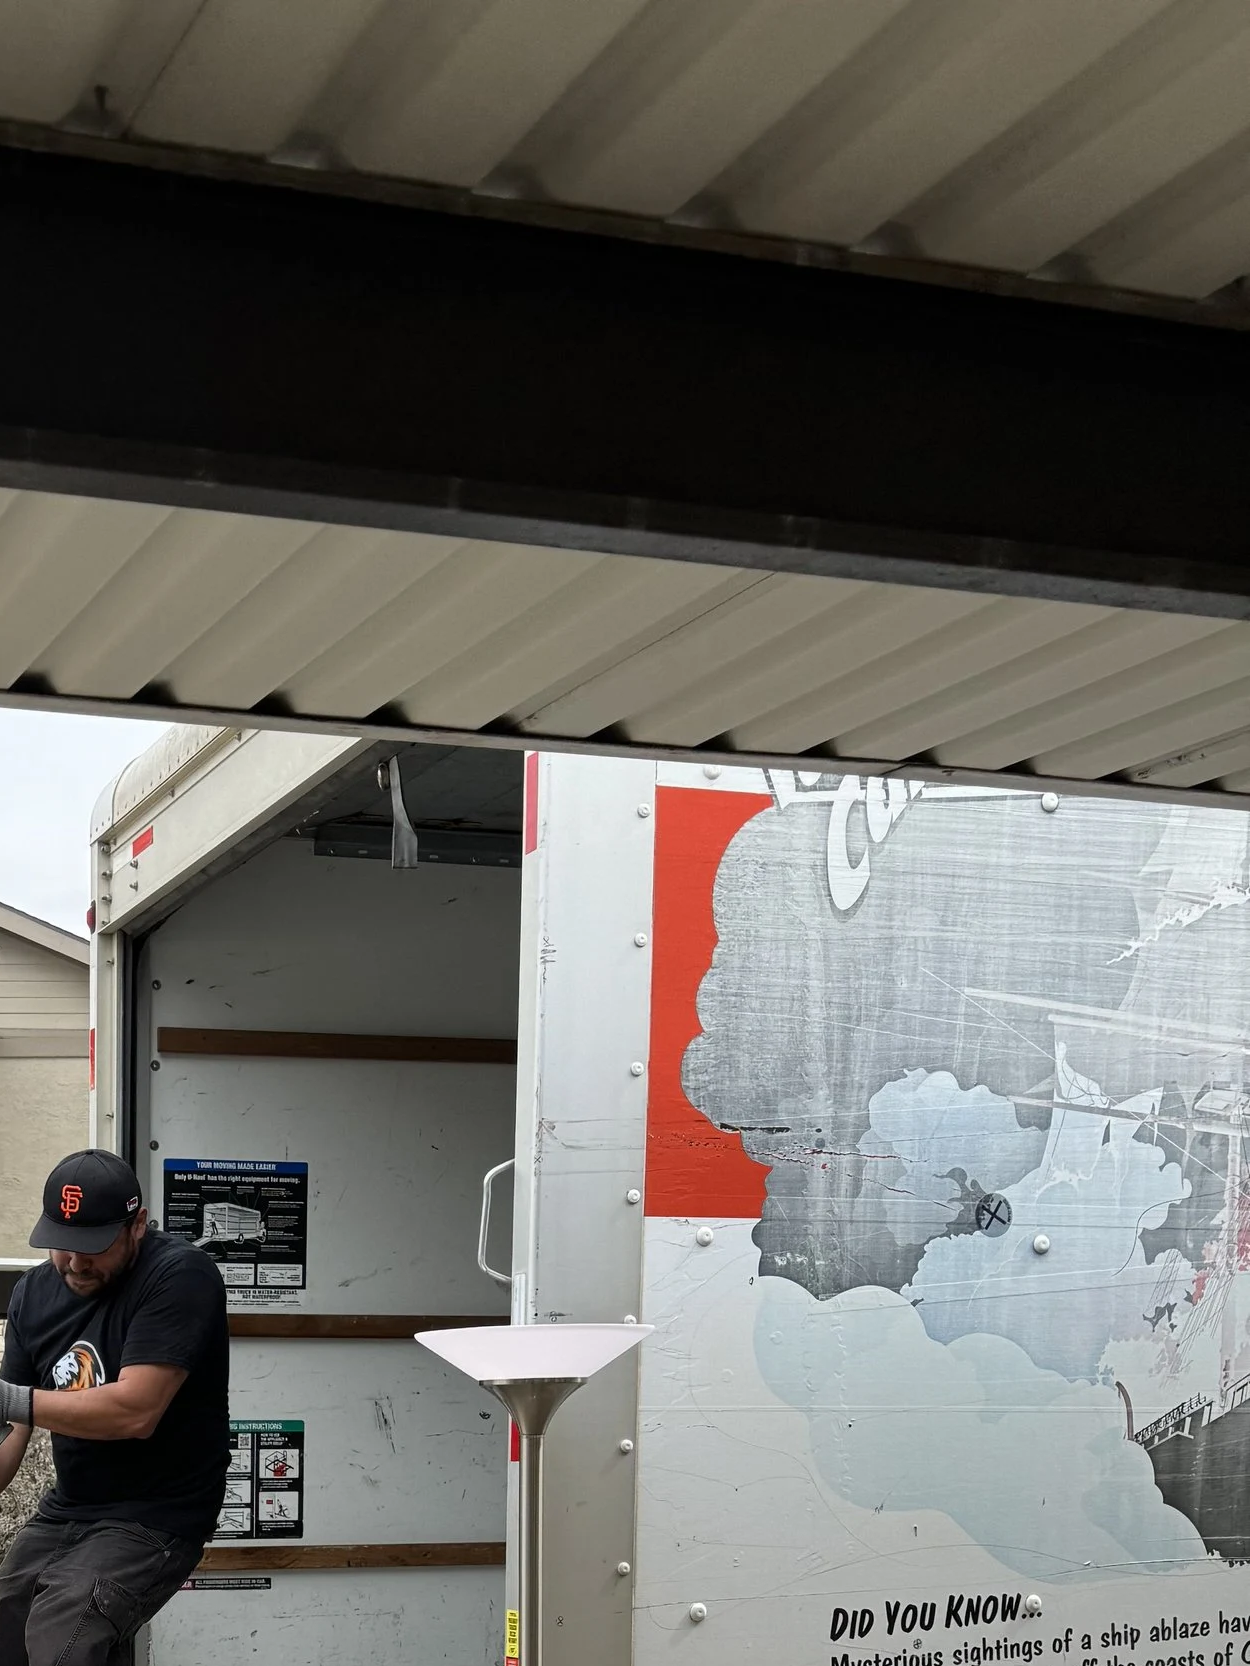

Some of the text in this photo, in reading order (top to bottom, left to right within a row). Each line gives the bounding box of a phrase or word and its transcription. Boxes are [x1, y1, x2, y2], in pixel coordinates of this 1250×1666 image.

[174, 1173, 186, 1181] Only
[197, 1161, 212, 1169] YOUR
[213, 1162, 236, 1170] MOVING
[237, 1162, 255, 1170] MADE
[830, 1592, 1042, 1641] DID YOU KNOW...
[1052, 1628, 1073, 1653] of
[1081, 1633, 1091, 1650] a
[1100, 1622, 1141, 1650] ship
[1149, 1616, 1210, 1642] ablaze
[1213, 1642, 1234, 1666] of
